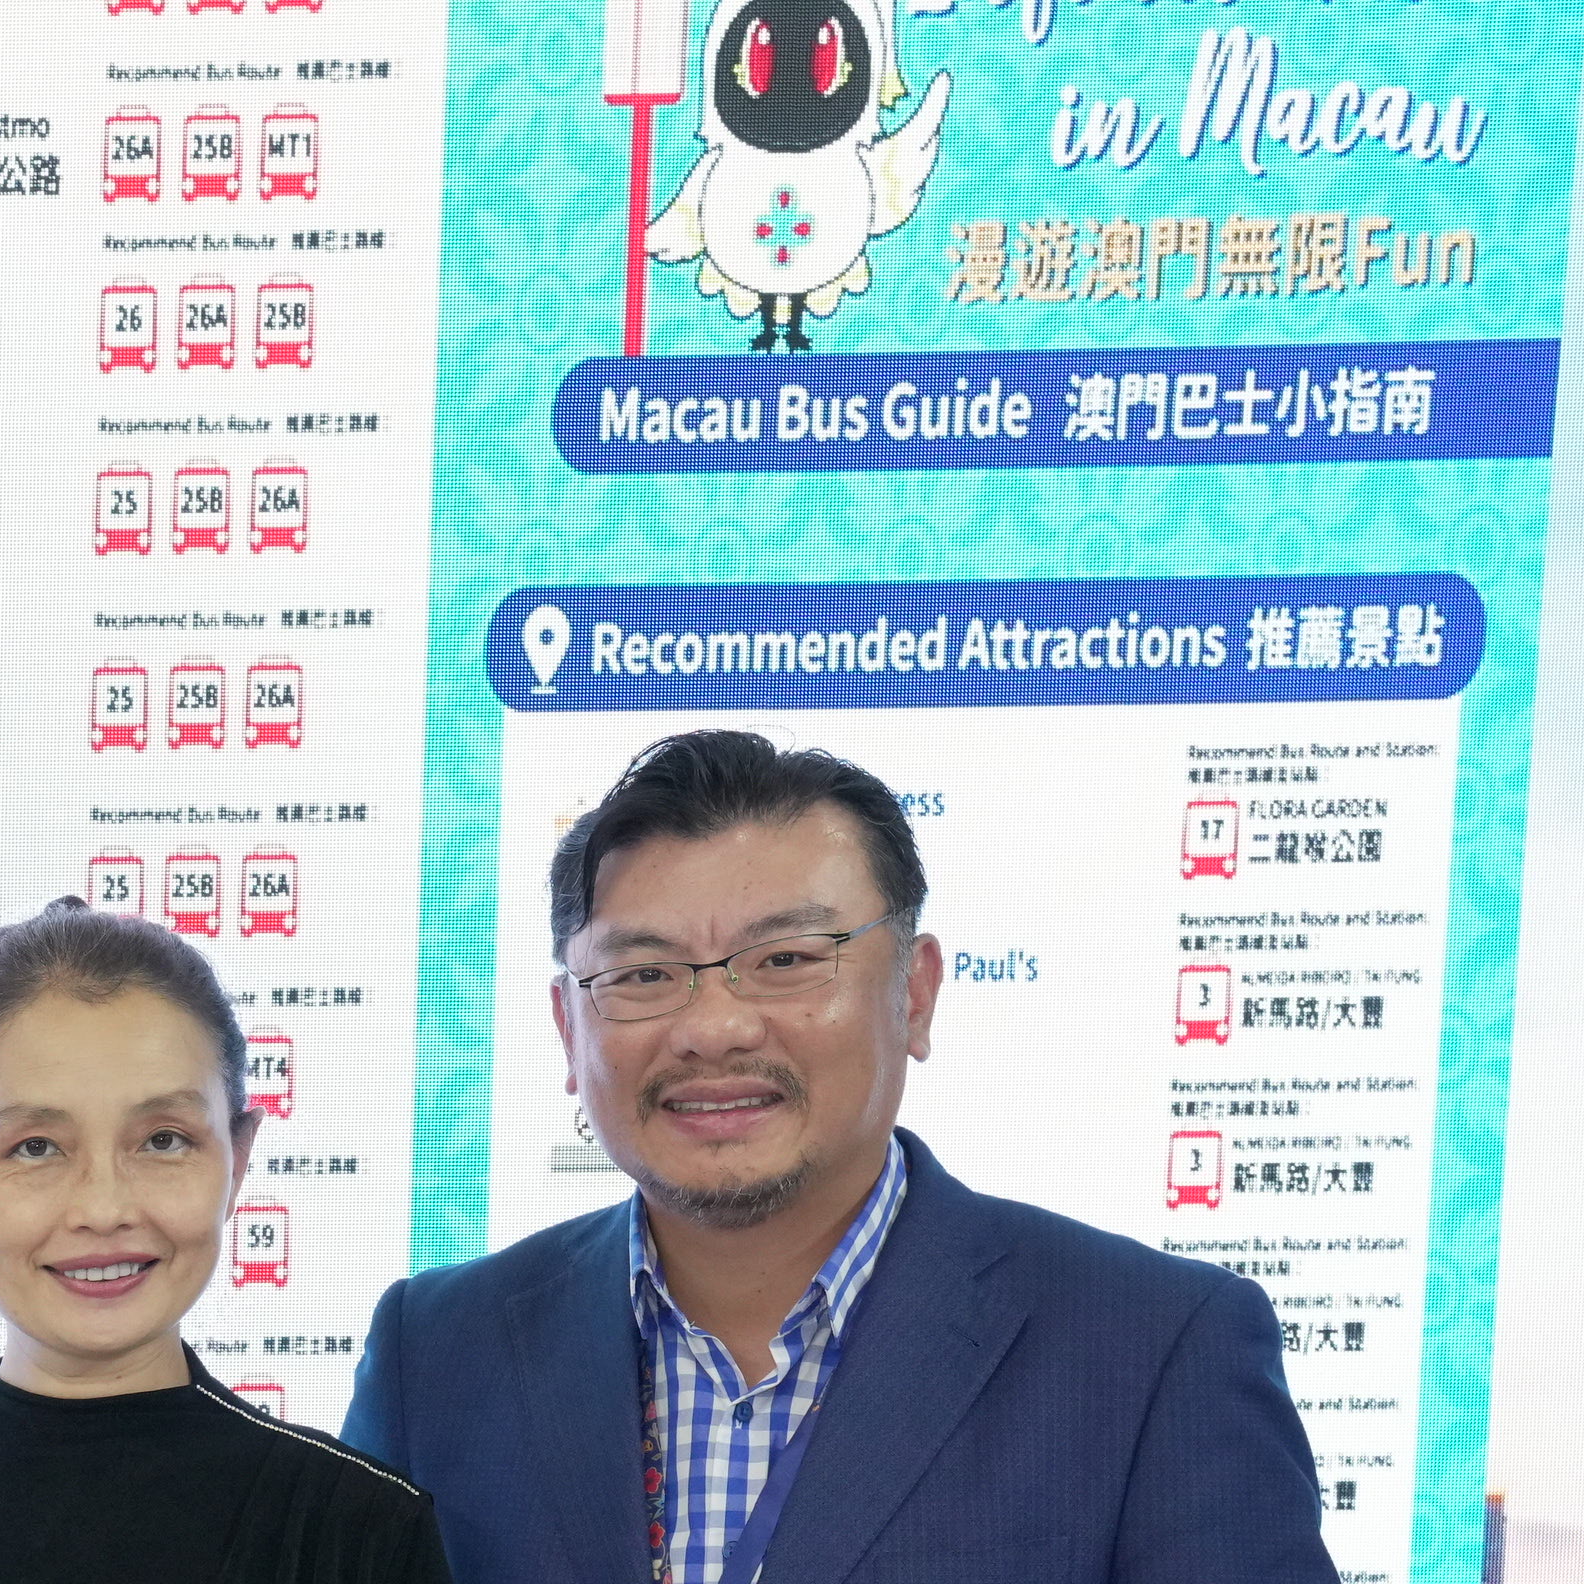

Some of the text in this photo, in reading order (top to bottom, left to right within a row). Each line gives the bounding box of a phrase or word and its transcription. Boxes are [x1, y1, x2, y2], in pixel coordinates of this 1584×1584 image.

[1050, 26, 1489, 174] in Macau
[111, 134, 155, 161] 26A
[190, 133, 234, 160] 25B
[268, 132, 312, 159] MT1
[947, 212, 1479, 307] 漫遊澳門無限Fun
[600, 366, 1438, 445] Macau Bus Guide 澳門巴士小指南
[110, 488, 138, 515] 25
[180, 486, 224, 514] 25B
[258, 484, 301, 512] 26A
[592, 602, 1444, 677] Recommended Attractions 推薦景點
[1200, 819, 1225, 841] 17
[954, 949, 1039, 983] Paul's
[1198, 985, 1212, 1007] 3
[247, 1224, 275, 1249] 59
